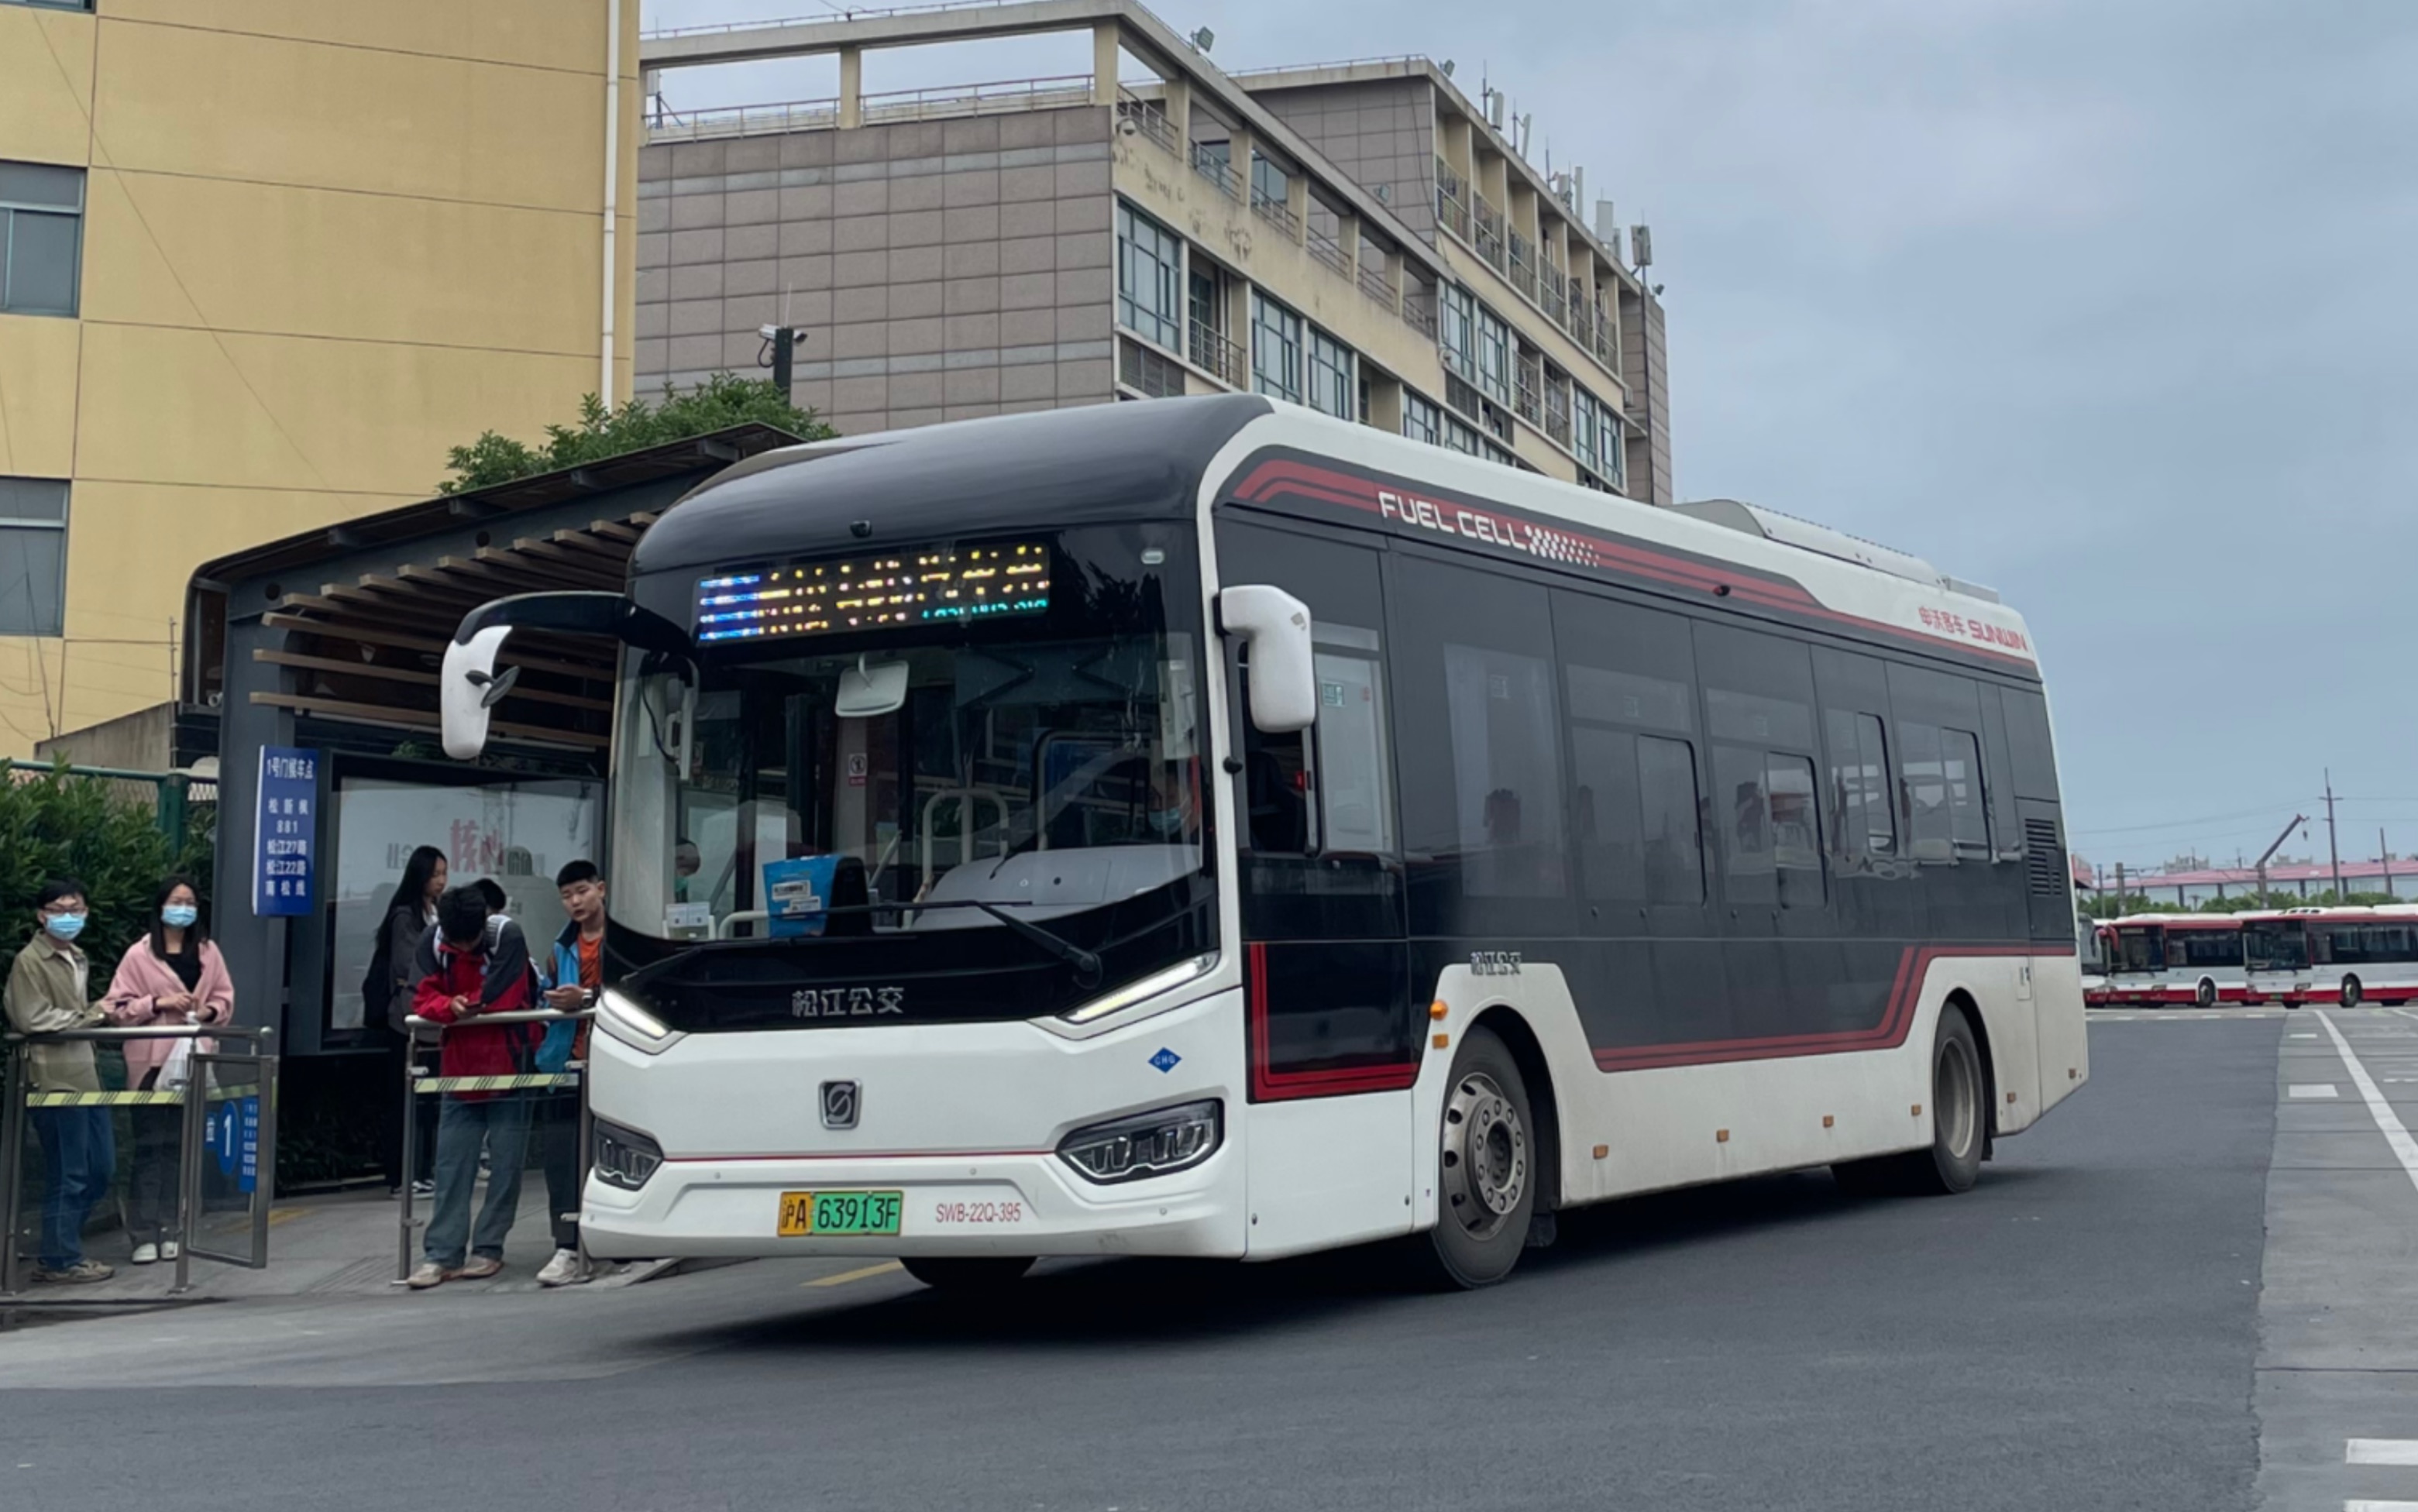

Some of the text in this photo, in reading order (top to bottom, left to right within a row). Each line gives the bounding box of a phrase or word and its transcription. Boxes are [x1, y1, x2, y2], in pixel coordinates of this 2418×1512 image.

[1378, 490, 1528, 551] FUEL CELL
[276, 820, 298, 833] 881
[267, 839, 307, 855] 松江27路
[266, 859, 306, 876] 松江22路
[792, 986, 905, 1018] 松江公交
[224, 1114, 232, 1157] 1
[817, 1198, 899, 1229] 63913F
[936, 1202, 1021, 1223] SWB-22Q-395
